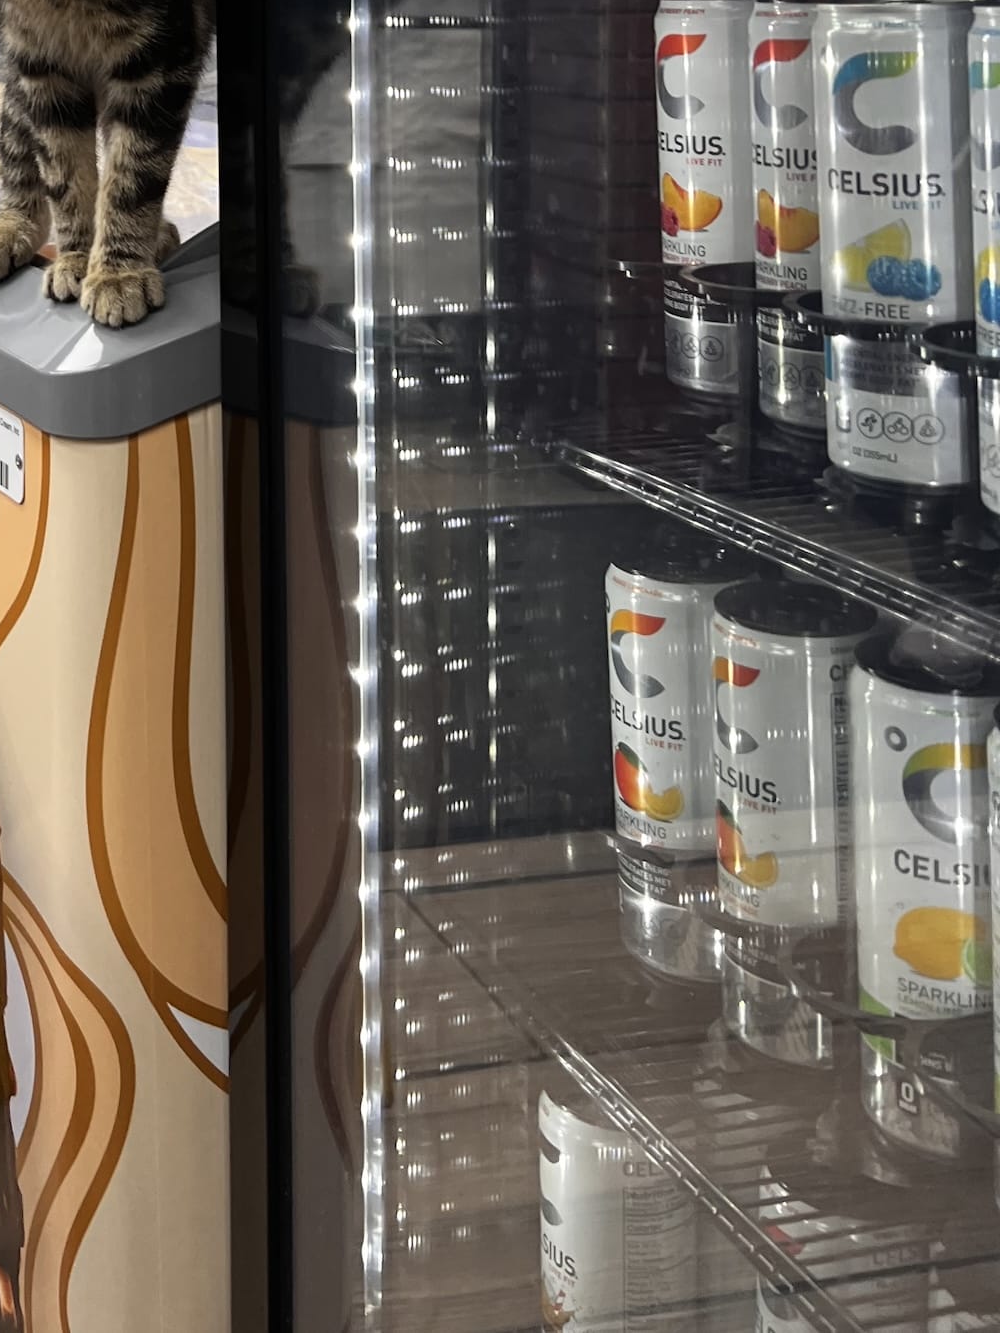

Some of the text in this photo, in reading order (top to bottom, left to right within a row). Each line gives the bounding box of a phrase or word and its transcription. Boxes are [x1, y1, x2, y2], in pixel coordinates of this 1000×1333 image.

[659, 131, 722, 156] ELSIUS
[752, 143, 817, 170] ELSIU
[708, 159, 722, 167] FIT
[828, 168, 942, 197] CELSIUS
[893, 200, 919, 210] LIVE
[667, 741, 683, 752] FIT
[897, 977, 993, 1009] SPARKLIN
[542, 1233, 576, 1278] SIUS
